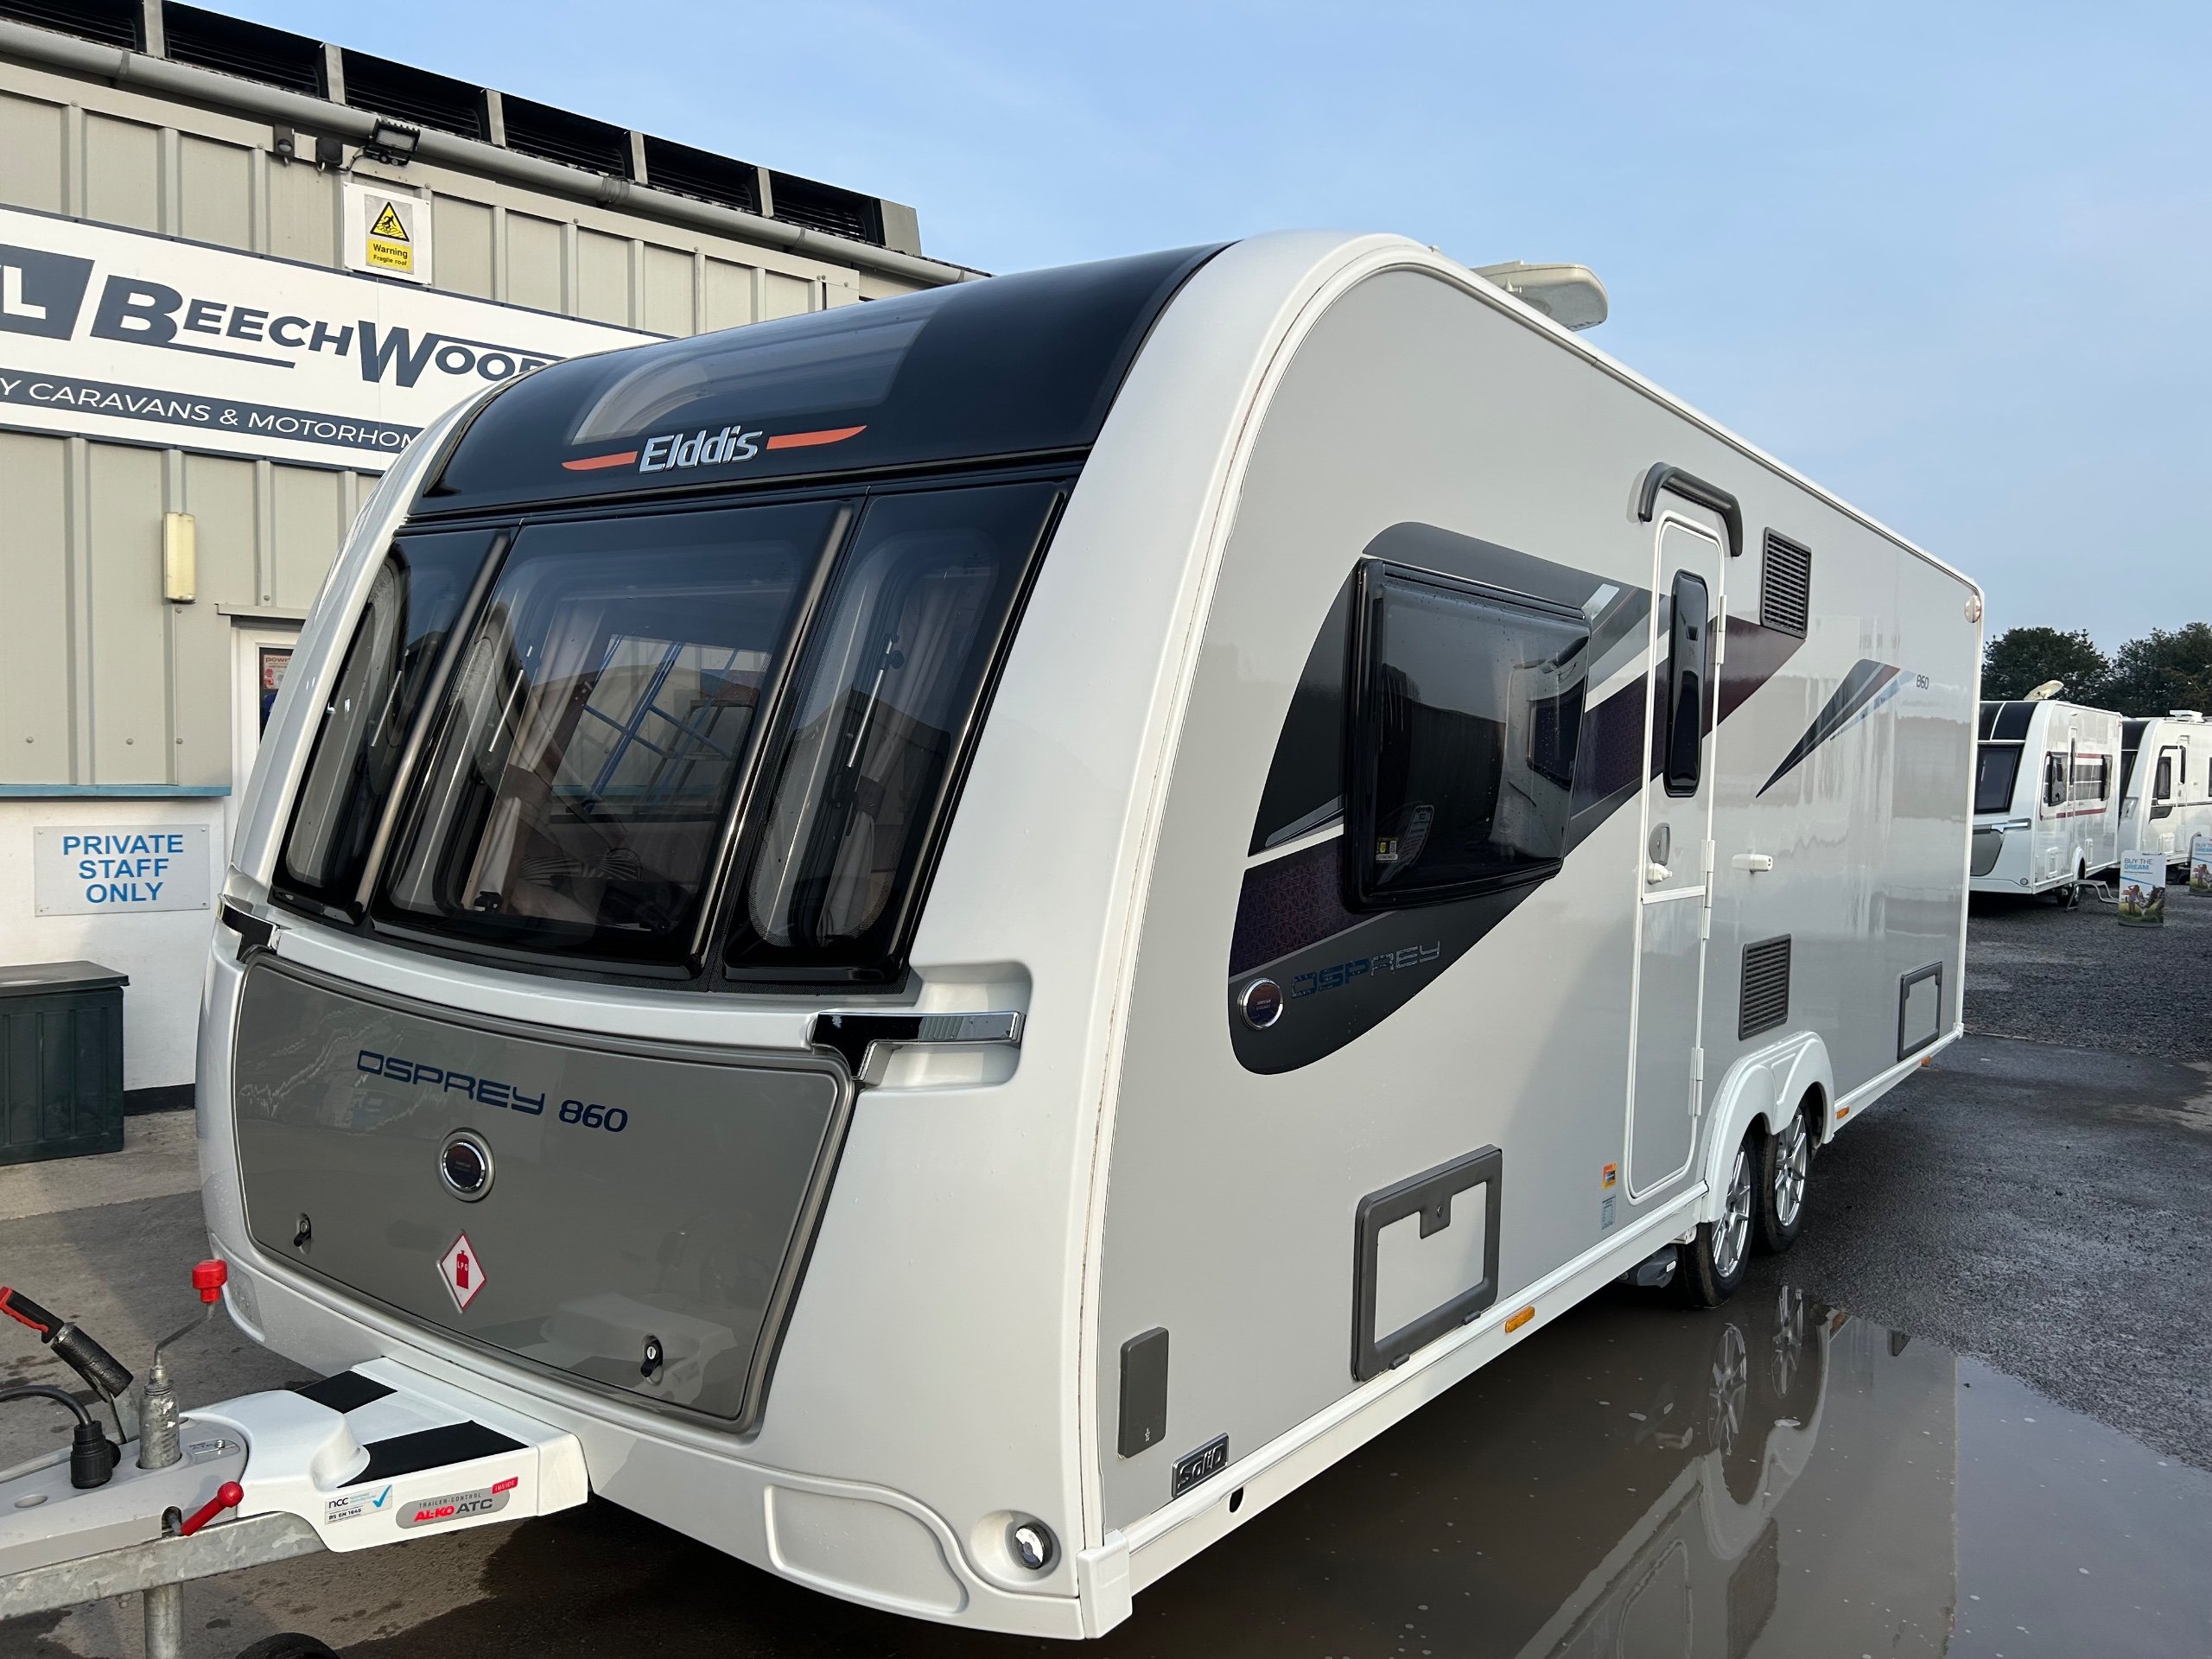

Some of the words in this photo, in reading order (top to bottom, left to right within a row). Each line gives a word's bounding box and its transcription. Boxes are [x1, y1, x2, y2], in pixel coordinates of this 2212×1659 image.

[372, 243, 408, 259] Warning
[373, 254, 393, 264] Fragile
[29, 382, 212, 423] CARAVANS
[219, 409, 239, 426] &
[639, 425, 763, 474] Elddis
[1916, 674, 1929, 690] 860
[62, 834, 184, 855] PRIVATE
[78, 858, 169, 880] STAFF
[86, 881, 164, 904] ONLY
[1290, 940, 1441, 1000] OSPREY
[356, 1049, 546, 1116] OSPREY
[558, 1099, 629, 1133] 860
[457, 1261, 468, 1272] LPG
[494, 1479, 516, 1492] INSIDE
[328, 1497, 349, 1509] ncc
[455, 1498, 493, 1515] ATC
